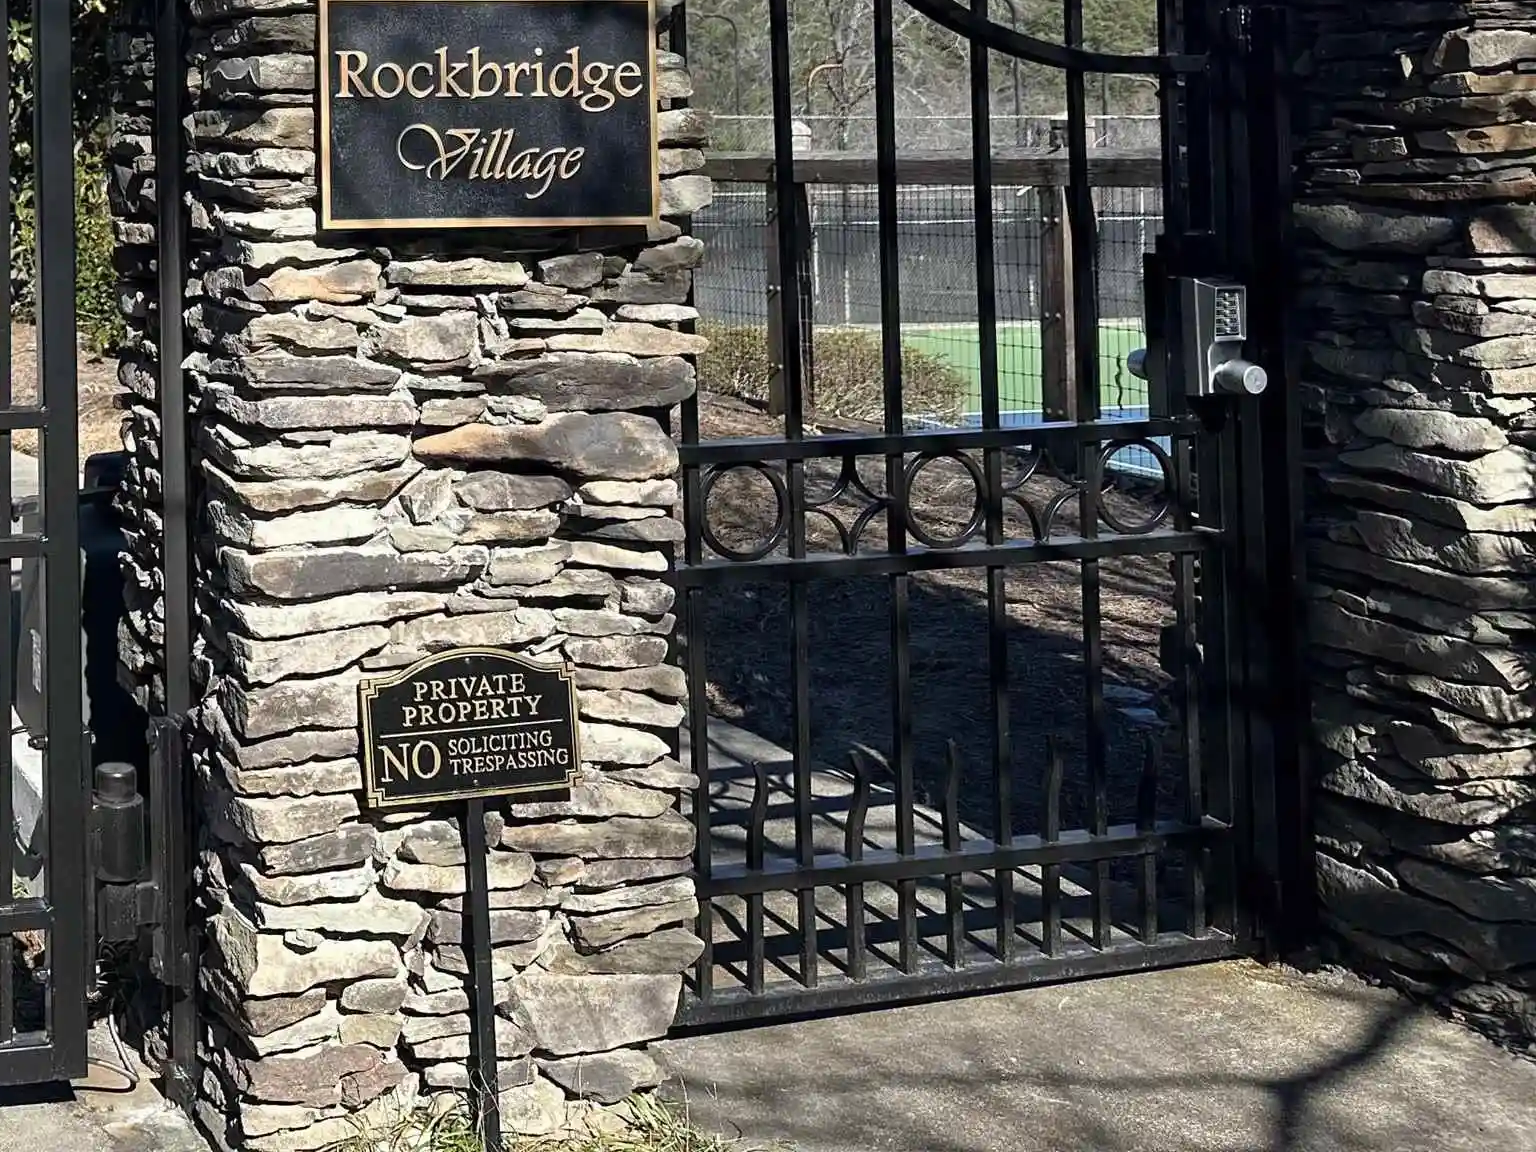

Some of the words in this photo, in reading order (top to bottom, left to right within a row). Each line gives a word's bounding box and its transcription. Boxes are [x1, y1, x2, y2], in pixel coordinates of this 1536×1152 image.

[334, 45, 644, 113] Rockbridge
[397, 123, 585, 200] Village
[413, 673, 527, 702] PRIVATE
[402, 694, 543, 727] PROPERTY
[448, 729, 553, 757] SOLICITING
[377, 740, 442, 784] NO
[449, 748, 569, 776] TRESPASSING
